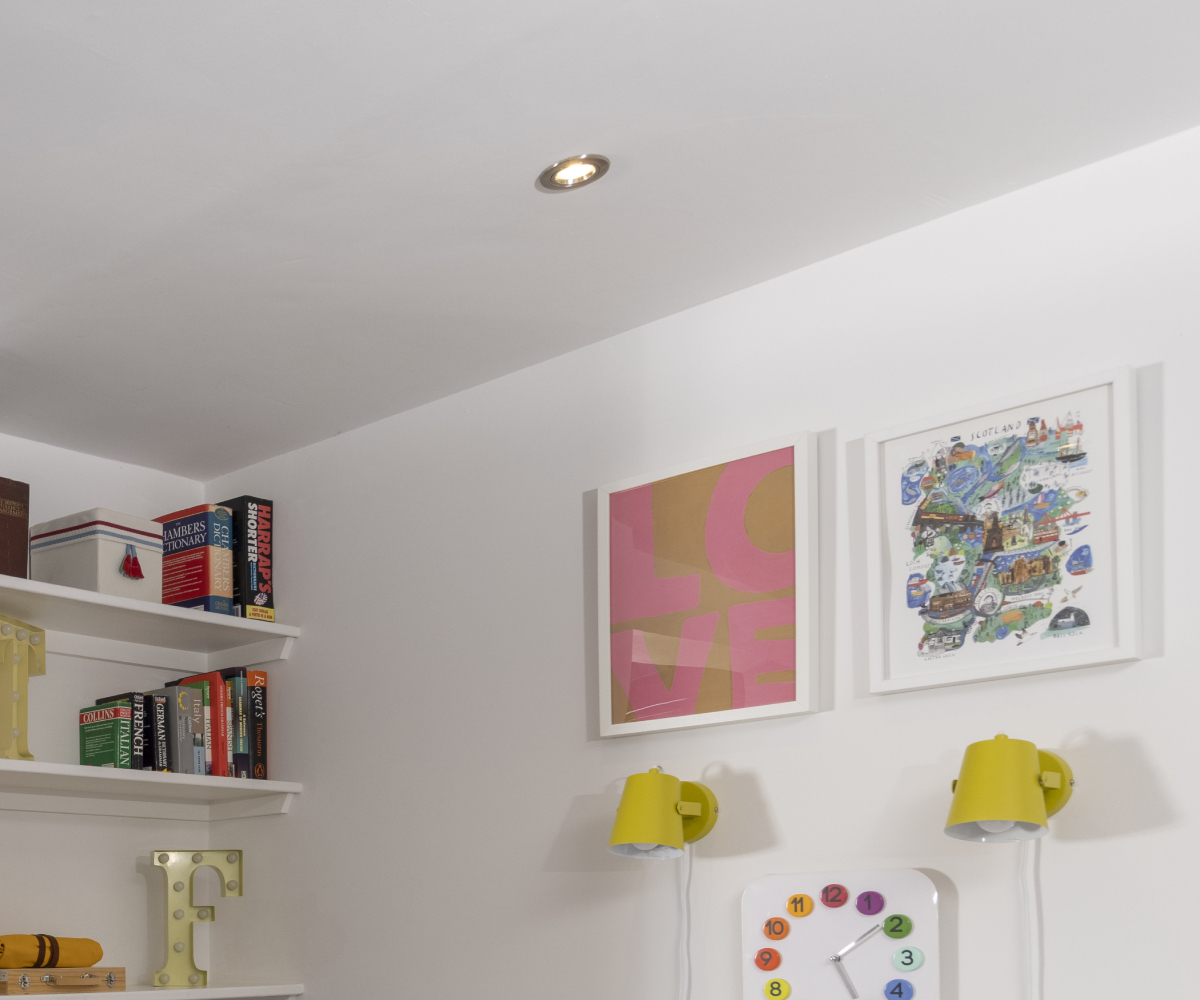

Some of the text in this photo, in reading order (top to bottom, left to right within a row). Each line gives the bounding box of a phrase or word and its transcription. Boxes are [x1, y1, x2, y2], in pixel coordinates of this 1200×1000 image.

[970, 421, 1022, 441] SCOTLAND
[163, 520, 206, 542] HAMBERS
[247, 502, 258, 562] SHORTER
[163, 532, 207, 552] CTIONARY
[258, 504, 272, 593] HARRAP'S
[214, 522, 222, 589] DICTIONARY
[221, 526, 230, 591] CHAMBERS
[252, 674, 265, 719] Roget's
[83, 708, 114, 723] COLLINS
[192, 699, 202, 724] Italy
[134, 704, 144, 756] FRENCH
[156, 704, 166, 740] GERMAN
[120, 720, 130, 766] ITALIAN
[791, 897, 803, 912] 11
[822, 887, 842, 902] 12
[864, 895, 871, 910] 1
[765, 920, 784, 935] 10
[890, 917, 903, 933] 2
[760, 951, 772, 966] 9
[901, 950, 914, 965] 3
[770, 982, 782, 996] 8
[890, 983, 903, 998] 4
